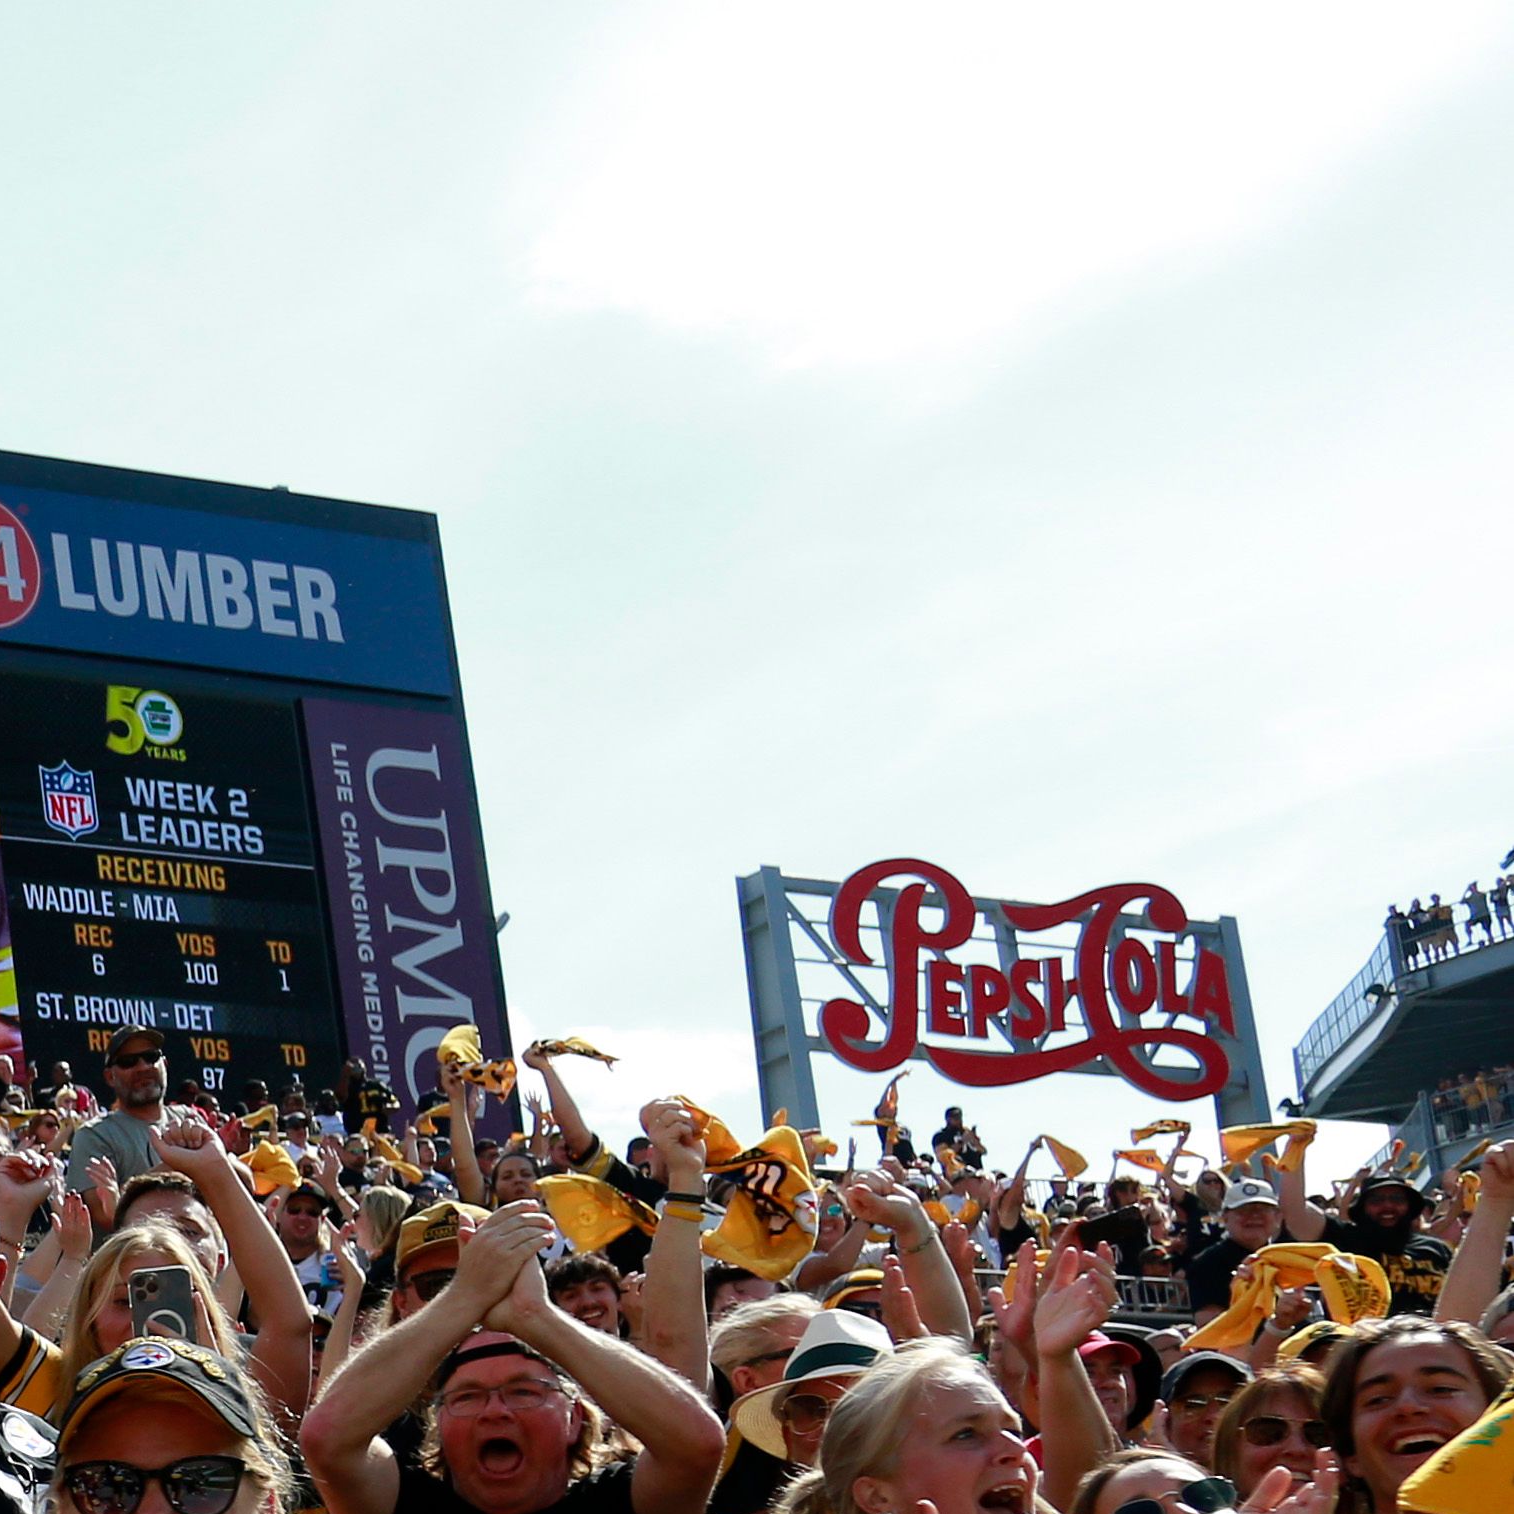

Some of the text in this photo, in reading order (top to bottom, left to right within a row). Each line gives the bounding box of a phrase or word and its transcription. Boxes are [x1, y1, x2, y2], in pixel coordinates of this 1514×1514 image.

[50, 531, 345, 645] LUMBER
[105, 684, 184, 756] 50
[144, 745, 188, 763] YEARS
[329, 741, 355, 804] LIFE
[46, 789, 94, 832] NFL
[124, 775, 251, 820] WEEK 2
[120, 810, 266, 857] LEADERS
[96, 855, 227, 893] RECEIVING
[338, 810, 376, 964] CHANGING
[22, 882, 116, 919] WADDLE
[132, 895, 180, 924] MIA
[73, 922, 293, 966] REC YDS TD
[364, 743, 488, 1122] UPMC
[91, 953, 292, 993] 6 100 1
[35, 992, 70, 1021] ST.
[74, 995, 158, 1029] BROWN
[173, 1003, 215, 1032] DET
[189, 1036, 232, 1063] YDS
[280, 1042, 308, 1068] TD
[201, 1065, 227, 1091] 97
